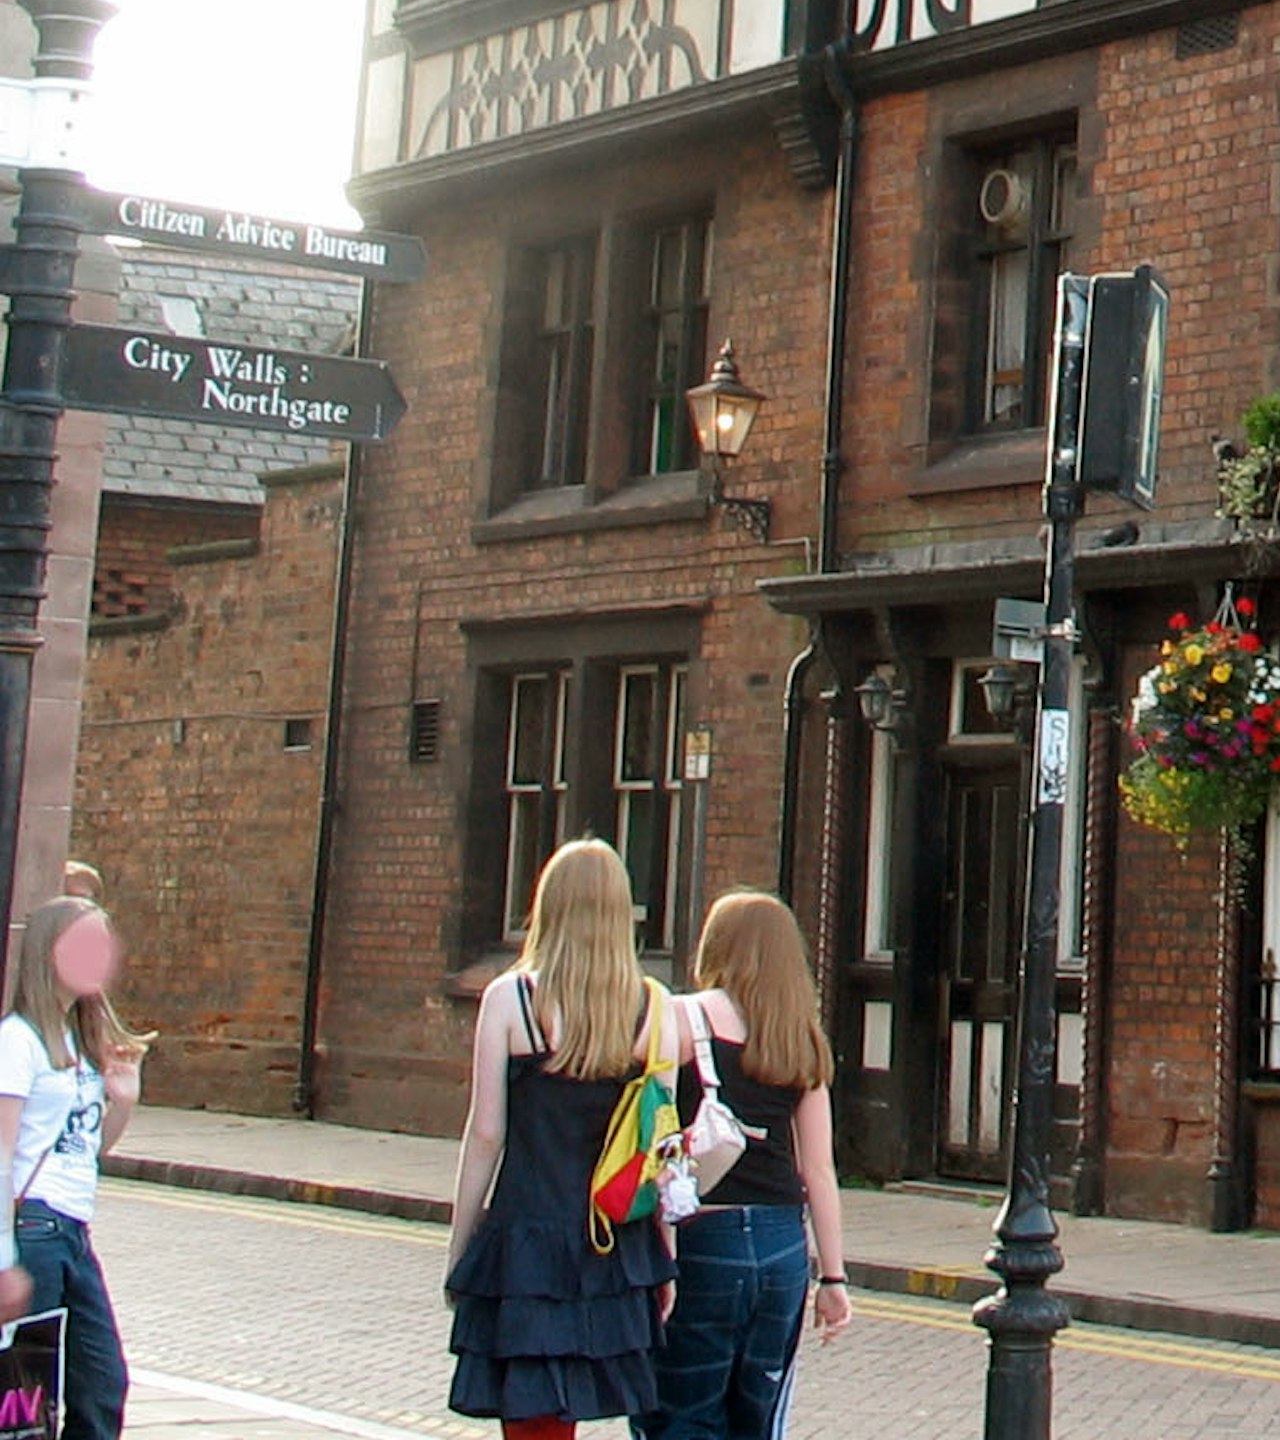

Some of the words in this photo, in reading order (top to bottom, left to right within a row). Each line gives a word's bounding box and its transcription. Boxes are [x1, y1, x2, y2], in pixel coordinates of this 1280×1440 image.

[119, 196, 204, 237] Citizen
[216, 211, 294, 251] Advice
[305, 225, 386, 265] Bureau
[124, 336, 190, 382] City
[207, 346, 287, 385] Walls
[202, 379, 349, 429] Northgate
